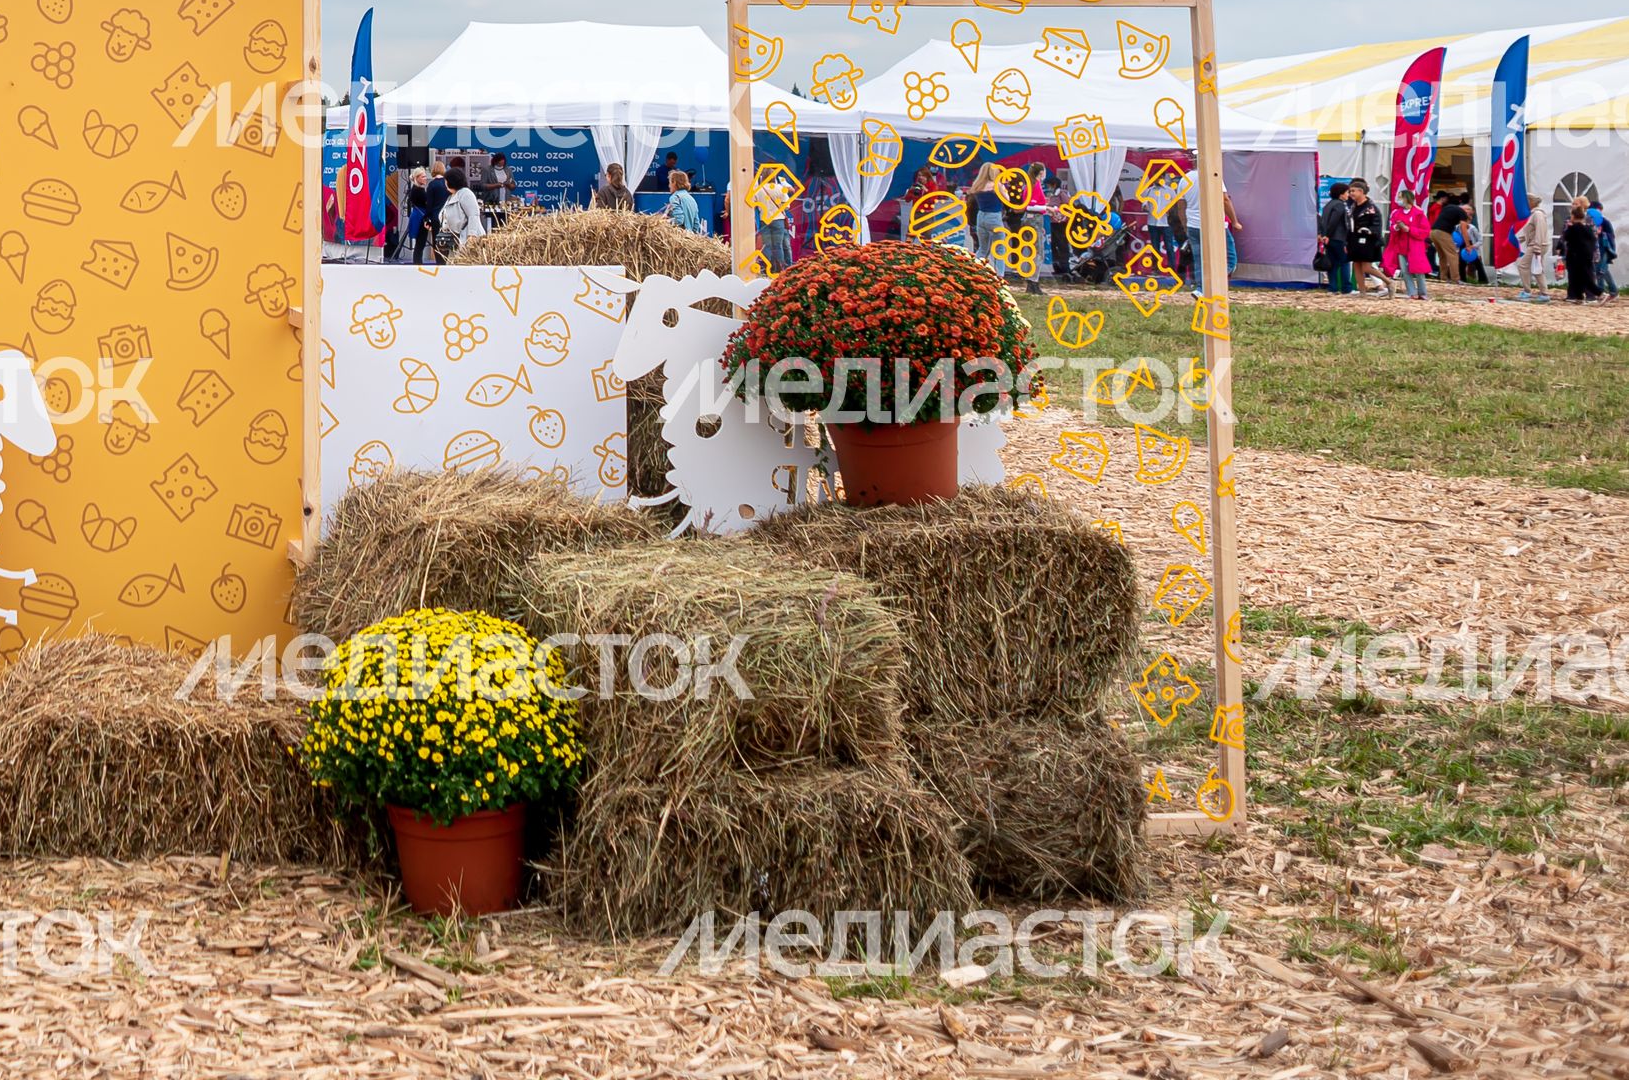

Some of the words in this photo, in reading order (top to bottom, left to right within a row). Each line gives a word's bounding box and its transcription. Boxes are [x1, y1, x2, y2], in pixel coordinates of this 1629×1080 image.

[349, 76, 372, 195] OZON
[510, 152, 539, 160] OZON
[545, 152, 574, 160] OZON
[1494, 101, 1525, 223] OZON
[530, 165, 559, 173] OZON
[514, 180, 539, 188] ZON
[545, 180, 574, 188] OZON
[537, 194, 559, 202] ZON
